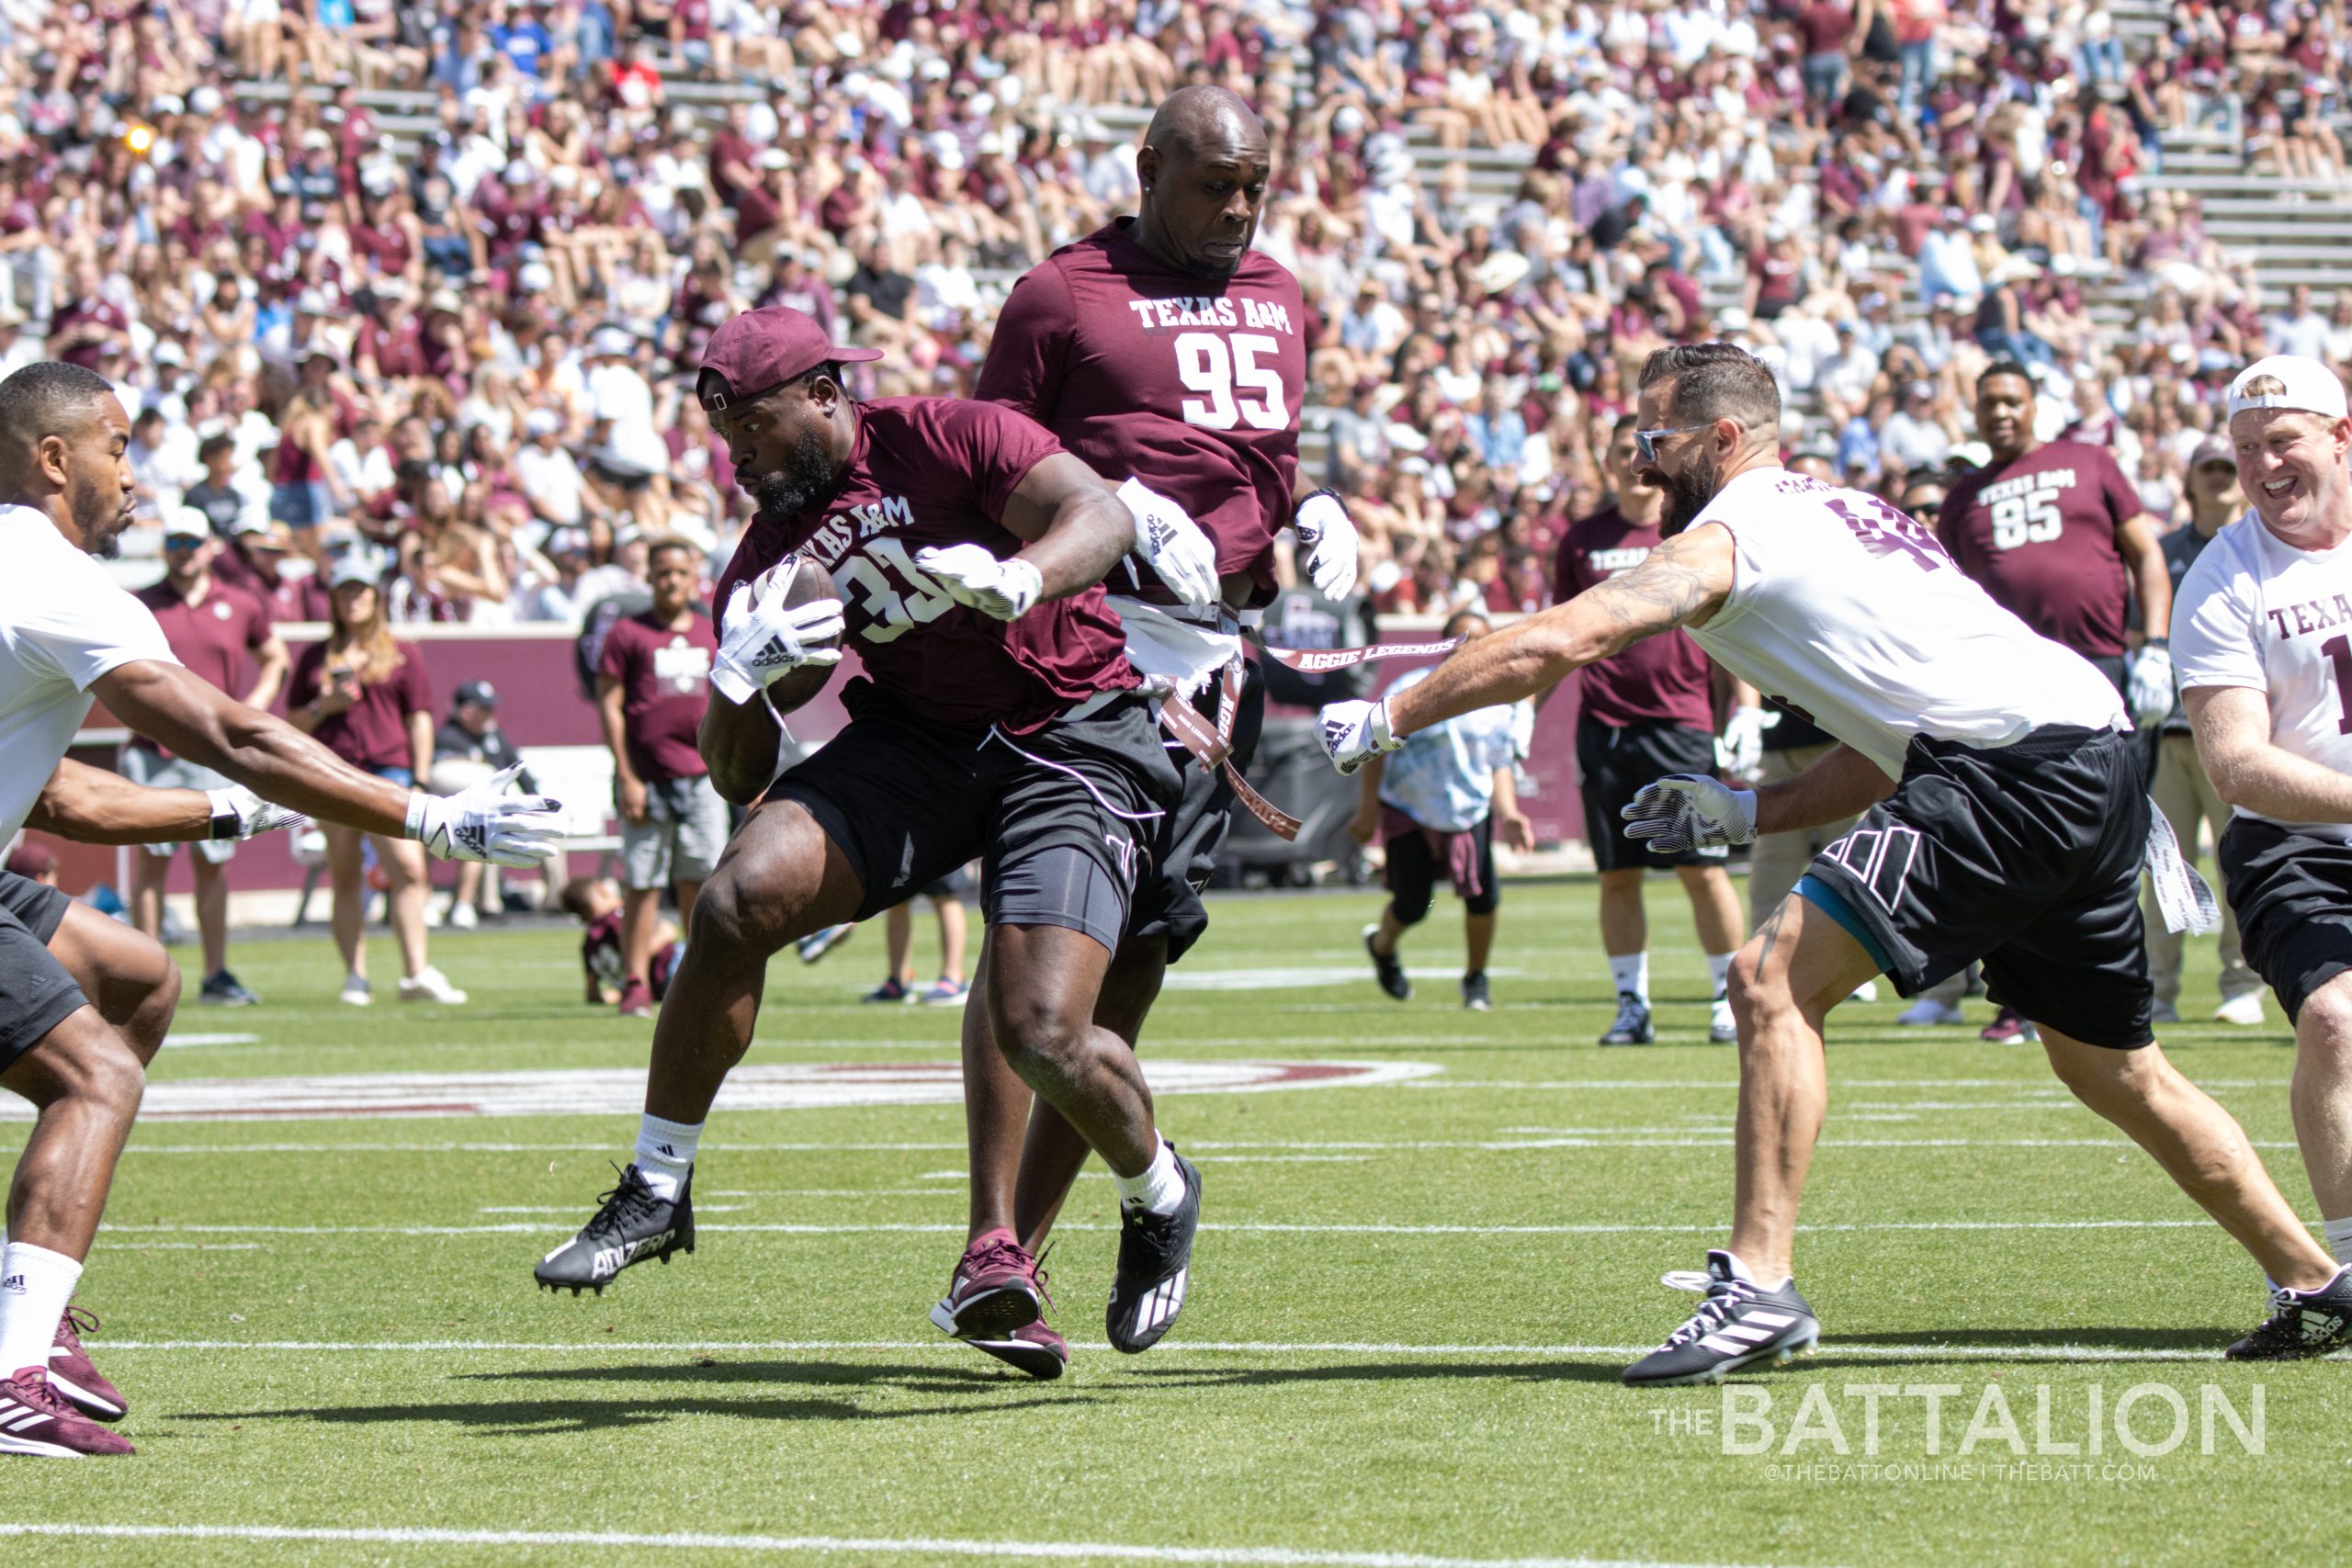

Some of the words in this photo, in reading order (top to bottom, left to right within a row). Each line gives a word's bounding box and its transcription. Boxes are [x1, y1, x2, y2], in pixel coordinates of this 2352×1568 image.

[1128, 297, 1238, 328] TEXAS
[1240, 298, 1293, 335] A&M
[1173, 333, 1290, 430] 95
[1978, 474, 2034, 506] TEXAS
[849, 495, 915, 538] A&M
[1147, 514, 1161, 555] adidas
[1991, 488, 2063, 550] 85
[752, 653, 795, 667] adidas
[1298, 650, 1361, 670] AGGIE
[1363, 638, 1457, 660] LEGENDS
[1330, 722, 1356, 758] adidas
[454, 826, 488, 859] adidas
